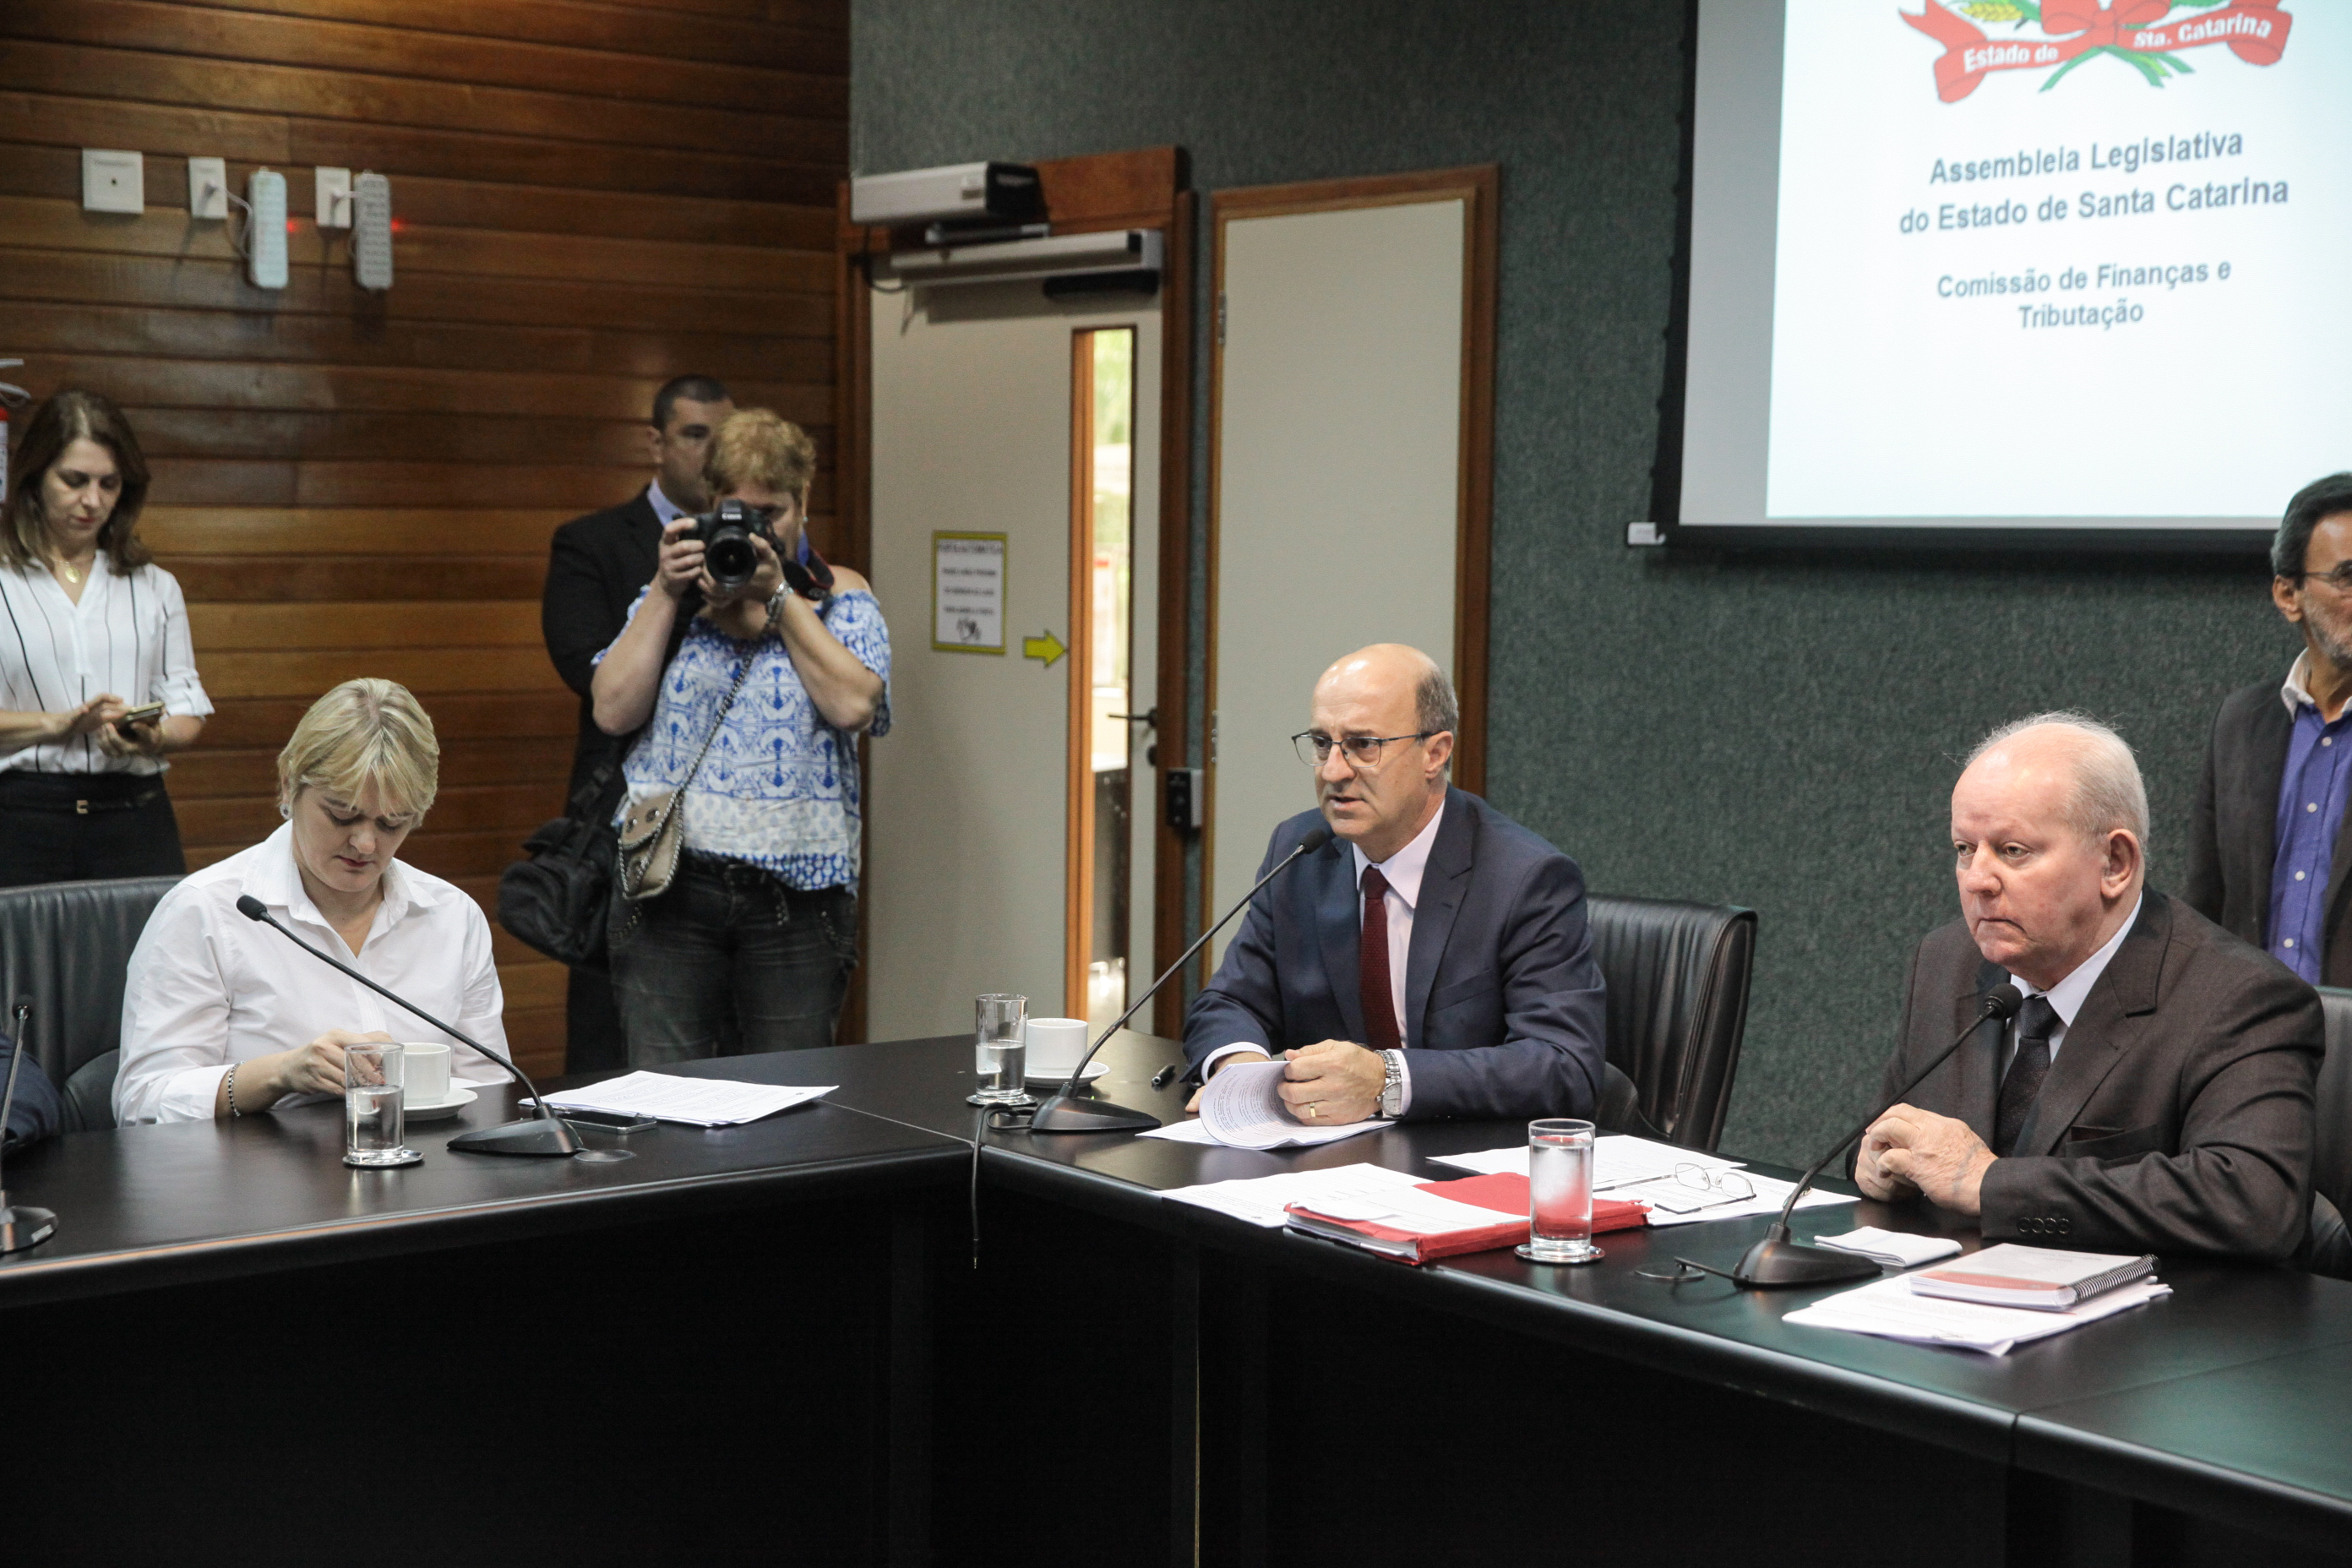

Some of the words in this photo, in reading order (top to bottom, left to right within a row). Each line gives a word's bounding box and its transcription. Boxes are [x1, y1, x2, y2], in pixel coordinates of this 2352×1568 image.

[1963, 42, 2031, 73] Estado
[2034, 44, 2060, 63] de
[2133, 28, 2173, 49] Sta.
[2177, 12, 2274, 44] Catarina
[1930, 146, 2081, 185] Assembleia
[2090, 131, 2245, 173] Legislativa
[1899, 208, 1930, 234] do
[1938, 199, 2028, 231] Estado
[2037, 195, 2069, 222] de
[2077, 188, 2157, 220] Santa
[2165, 177, 2290, 212] Catarina
[1936, 269, 2052, 299] Comissão
[2058, 266, 2088, 291] de
[2096, 257, 2209, 290] Finanças
[2217, 261, 2232, 280] e
[2018, 298, 2145, 330] Tributação
